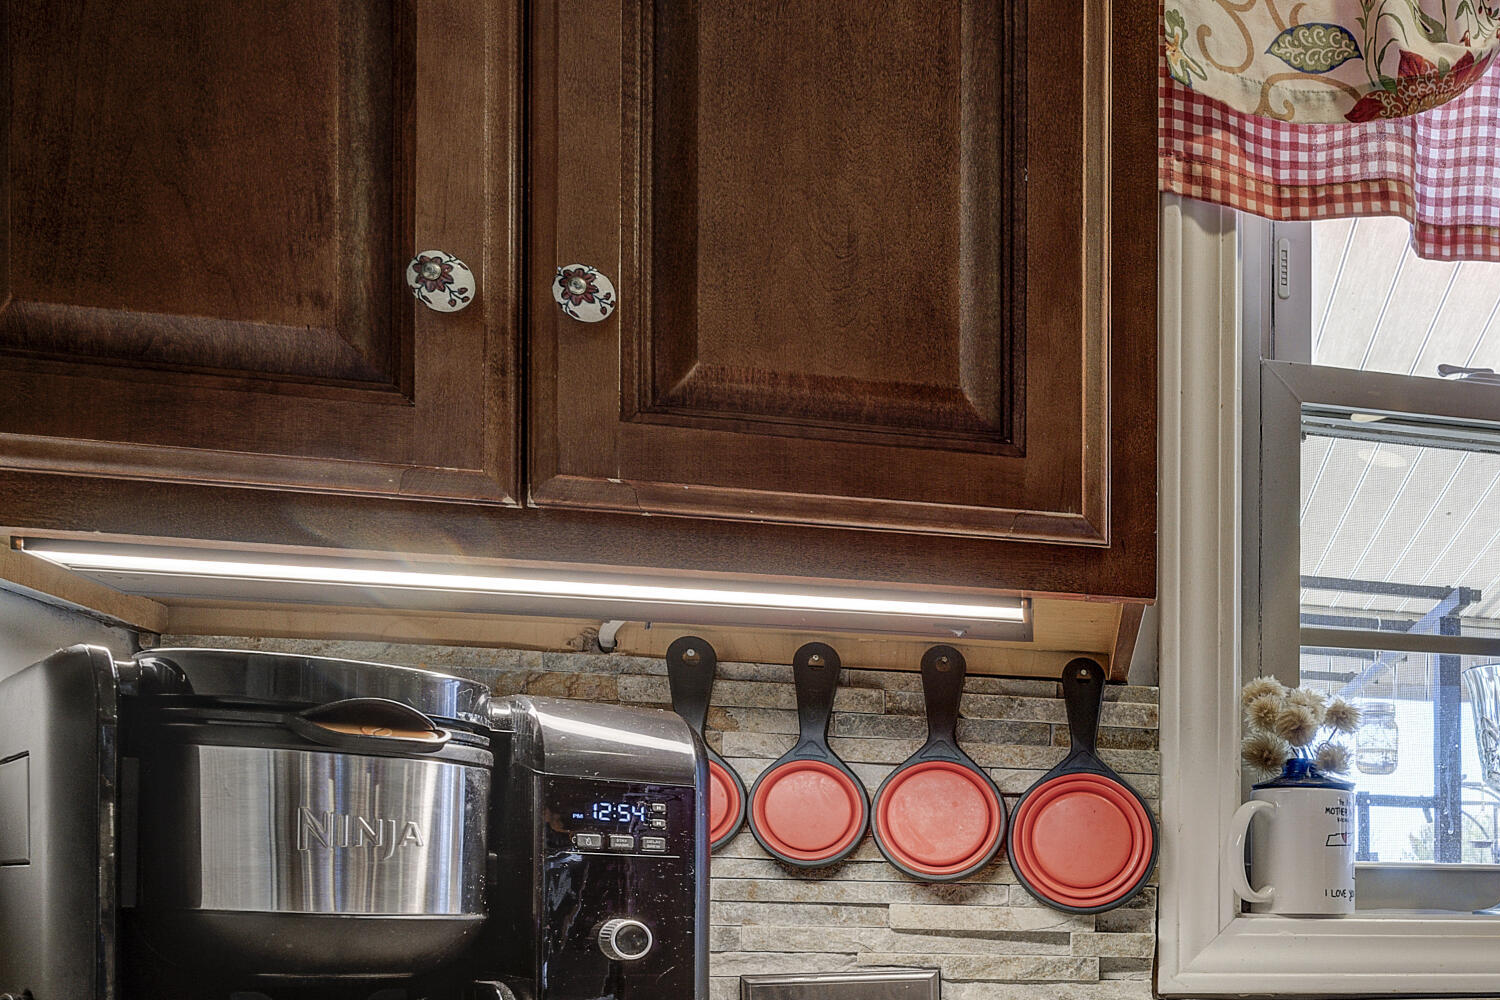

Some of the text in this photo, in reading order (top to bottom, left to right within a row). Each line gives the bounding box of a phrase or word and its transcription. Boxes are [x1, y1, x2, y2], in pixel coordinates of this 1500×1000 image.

[592, 802, 645, 822] 12:54
[297, 807, 424, 861] NINJA
[1331, 889, 1347, 898] LOVE
